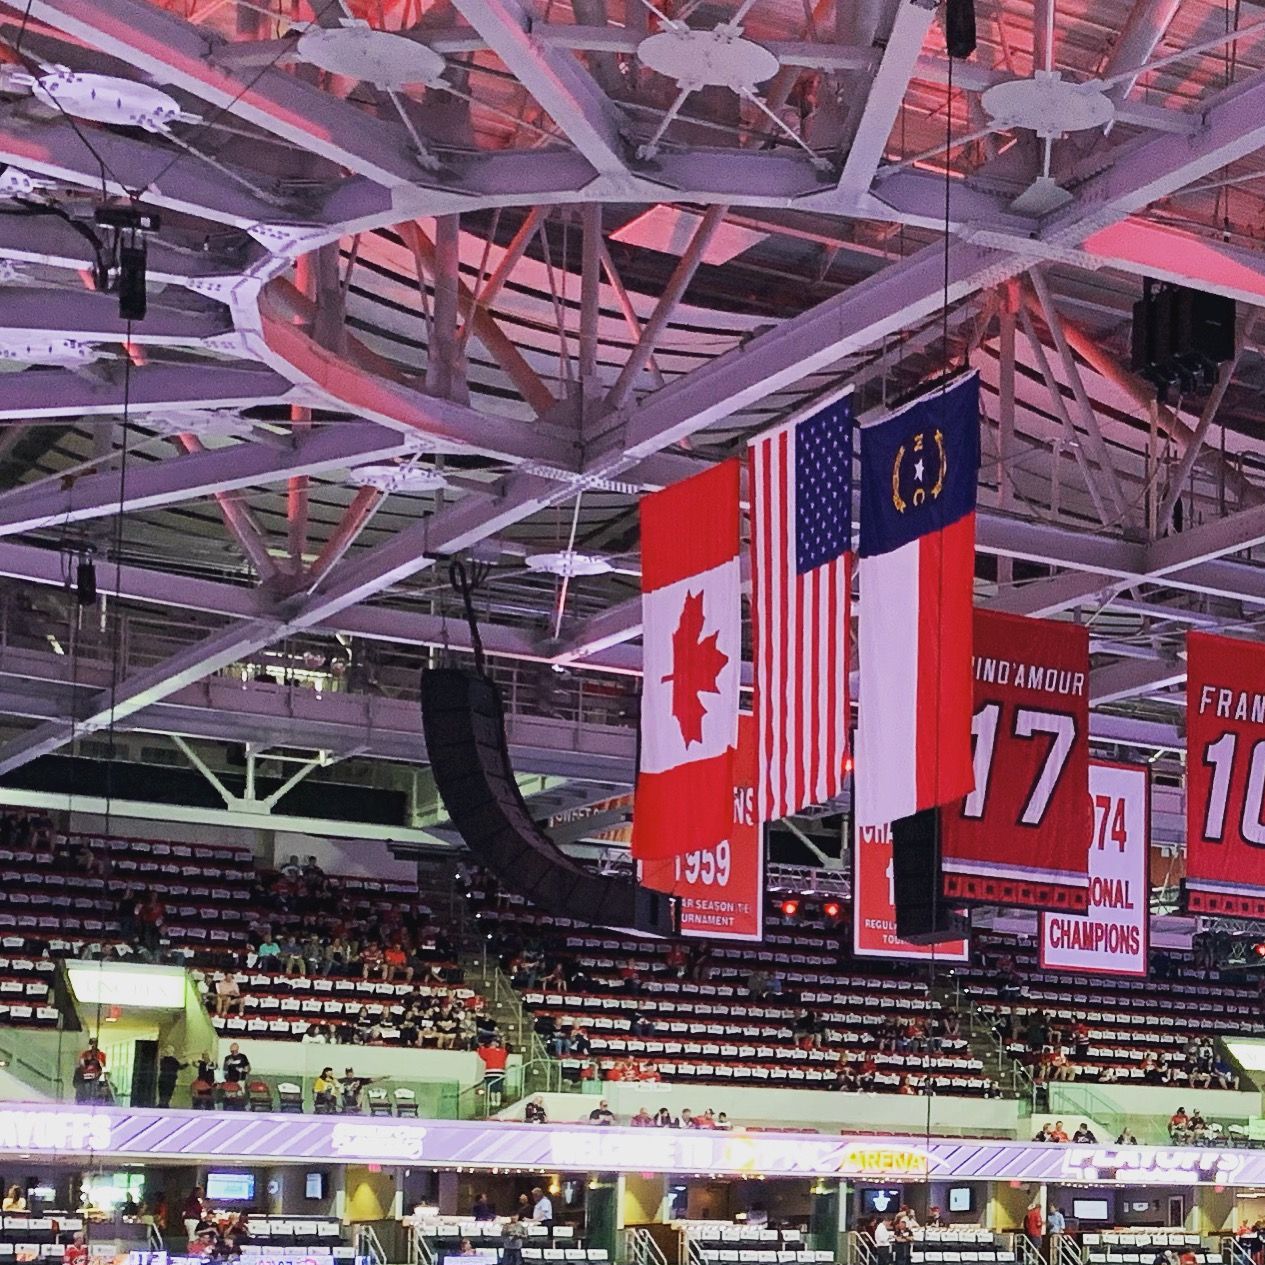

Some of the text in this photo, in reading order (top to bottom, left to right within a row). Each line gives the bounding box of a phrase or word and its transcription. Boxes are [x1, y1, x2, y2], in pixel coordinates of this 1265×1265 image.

[971, 655, 1085, 697] IND'AMOUR
[963, 703, 1077, 826] 17
[1088, 792, 1127, 852] 74
[695, 899, 734, 912] SEASON
[1087, 876, 1134, 909] IONAL
[681, 913, 735, 926] URNAMENT
[864, 918, 898, 931] REGUL
[1049, 918, 1140, 955] CHAMPIONS
